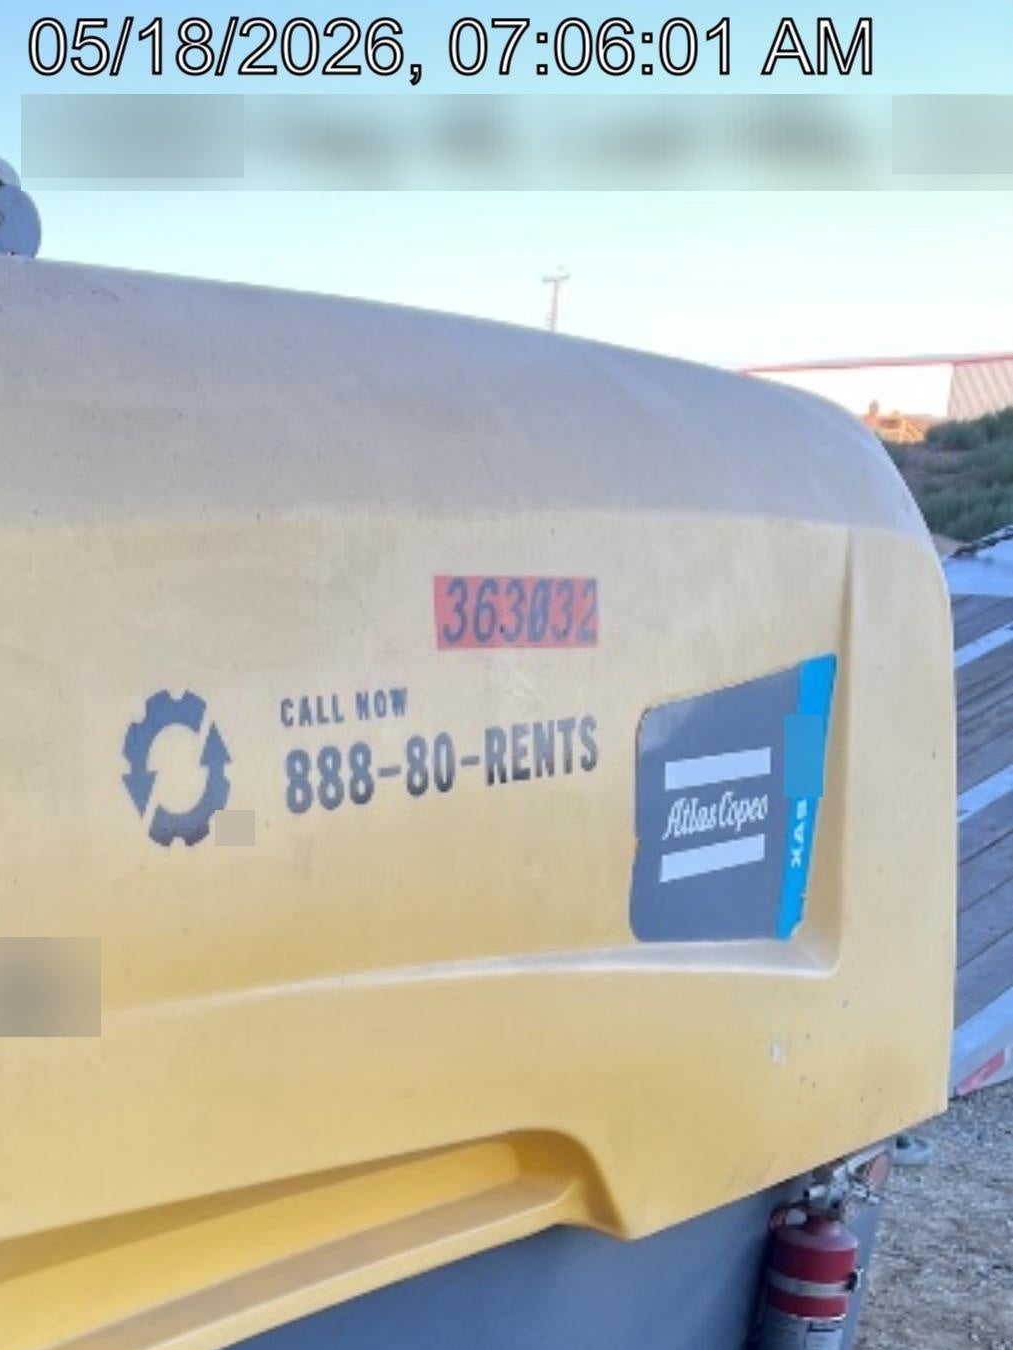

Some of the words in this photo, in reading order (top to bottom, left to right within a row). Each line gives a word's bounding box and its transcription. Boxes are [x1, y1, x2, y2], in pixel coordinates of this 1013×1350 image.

[443, 577, 597, 643] 363032
[280, 694, 344, 727] CALL
[355, 687, 407, 720] NOW
[285, 715, 599, 814] 888-80-RENTS
[661, 797, 718, 841] Atlas
[718, 791, 768, 832] Copco
